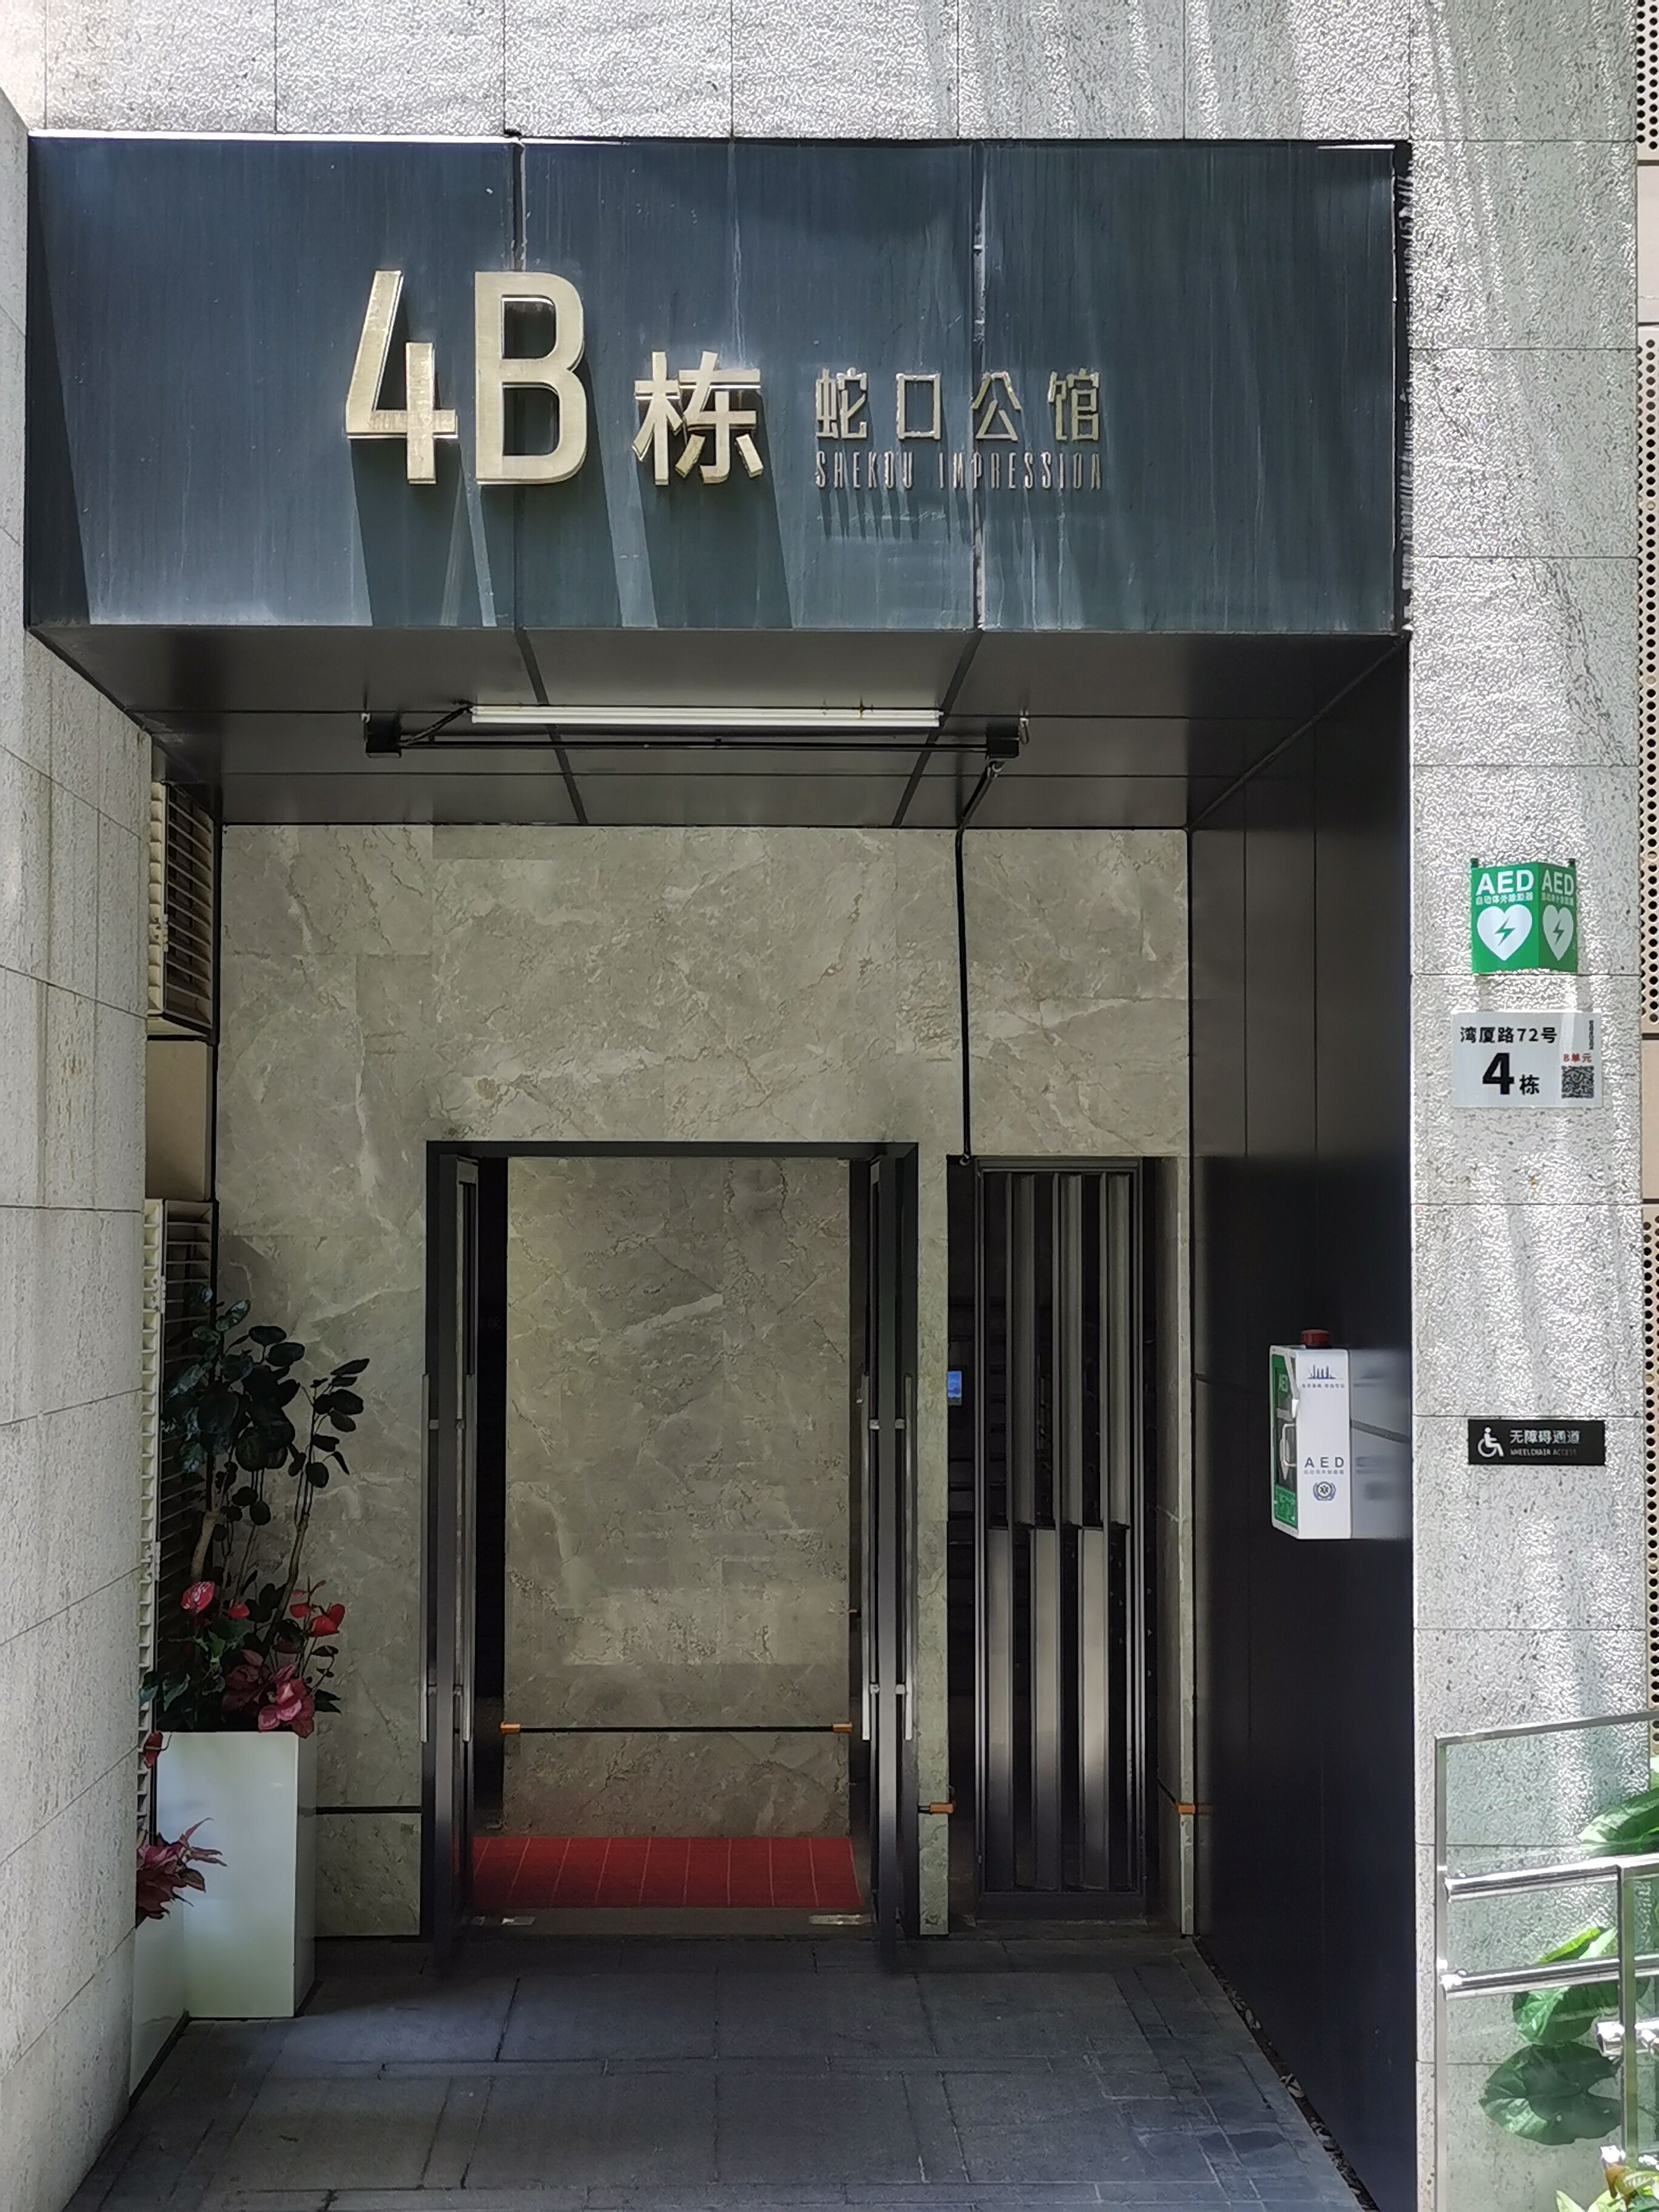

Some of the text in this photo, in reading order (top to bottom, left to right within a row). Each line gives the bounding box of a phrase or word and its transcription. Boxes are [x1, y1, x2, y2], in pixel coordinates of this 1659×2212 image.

[816, 367, 1099, 441] 蛇口公馆
[816, 452, 1101, 489] SHEKOU IMPRESSION
[1476, 870, 1534, 896] AED
[1541, 870, 1574, 896] AED
[1460, 1026, 1557, 1044] 湾厦路72号
[1510, 1429, 1581, 1445] 无障碍通道
[1304, 1456, 1344, 1468] AED
